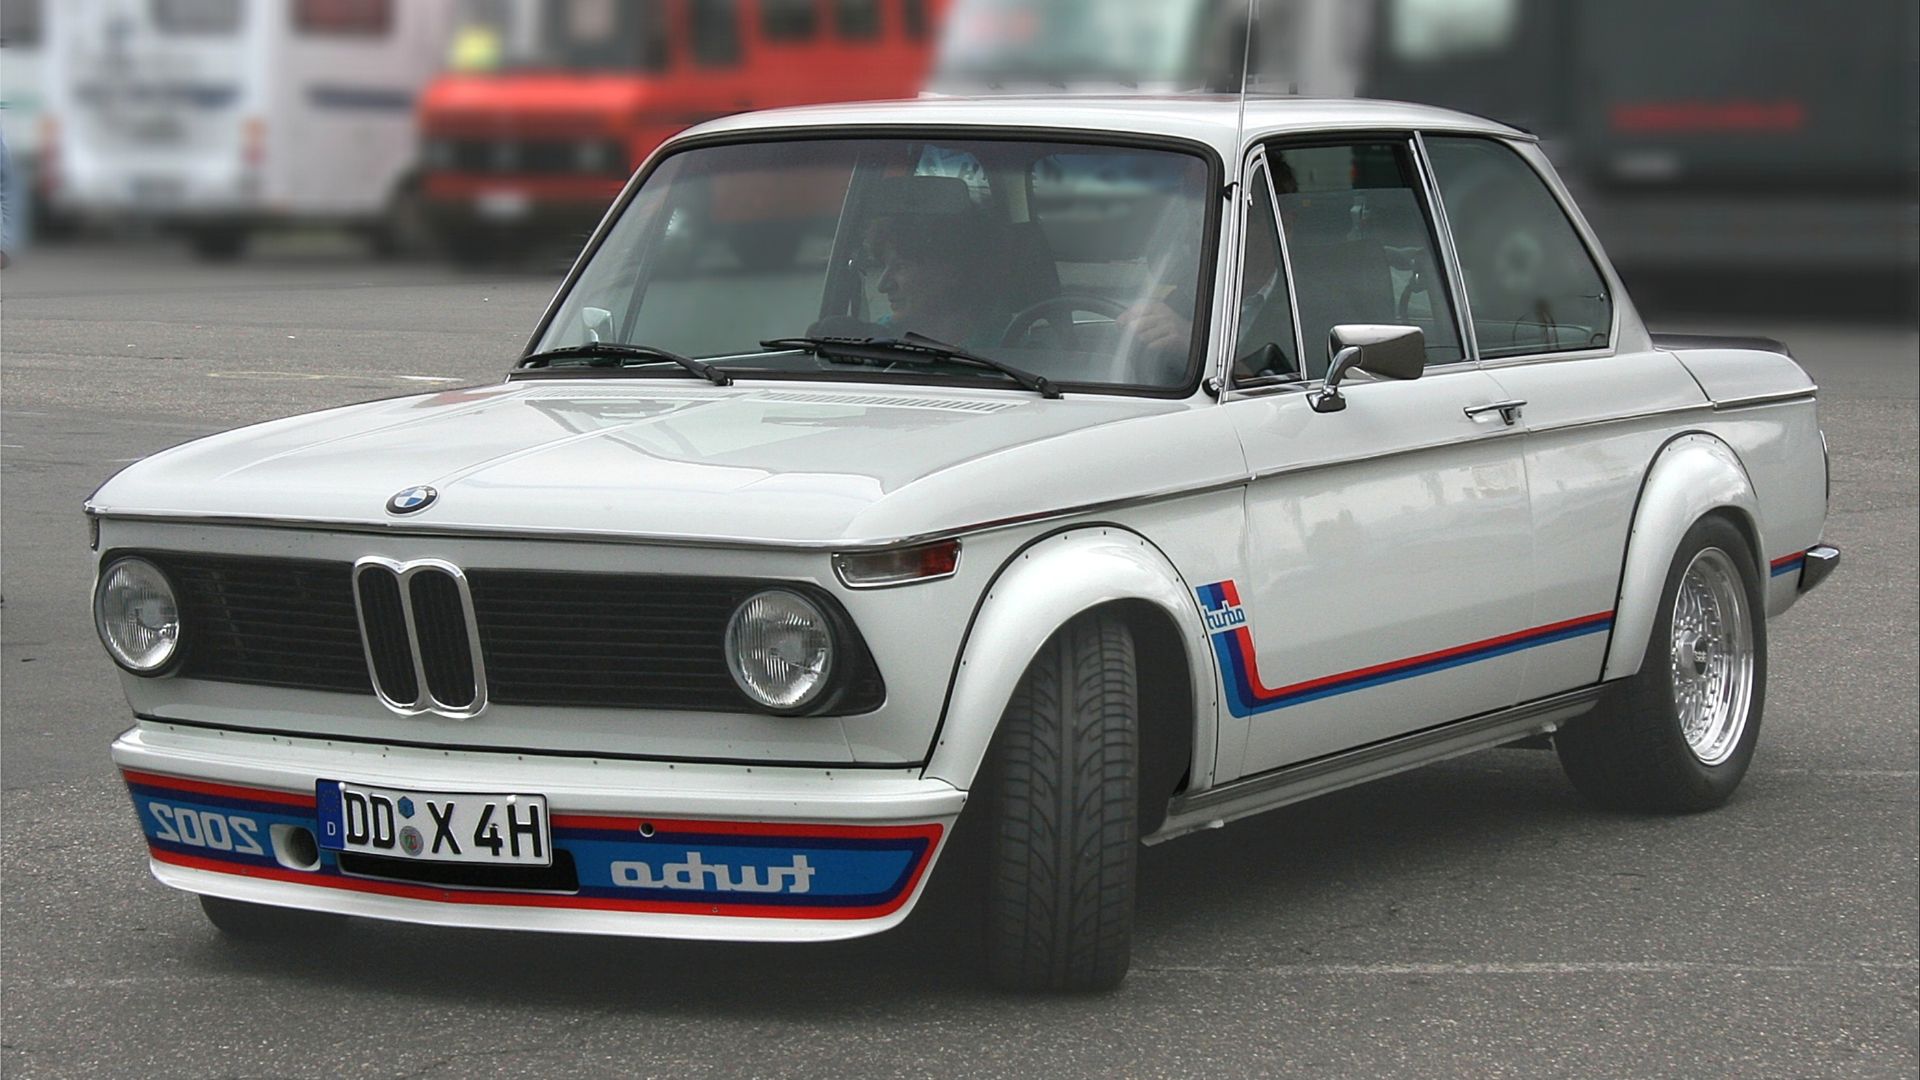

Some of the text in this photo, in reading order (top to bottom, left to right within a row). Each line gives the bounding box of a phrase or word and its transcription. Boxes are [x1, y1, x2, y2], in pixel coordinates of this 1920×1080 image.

[1203, 603, 1246, 630] turbo
[327, 821, 336, 836] D
[343, 790, 396, 849] DD
[426, 801, 461, 855] X
[473, 802, 543, 858] 4H
